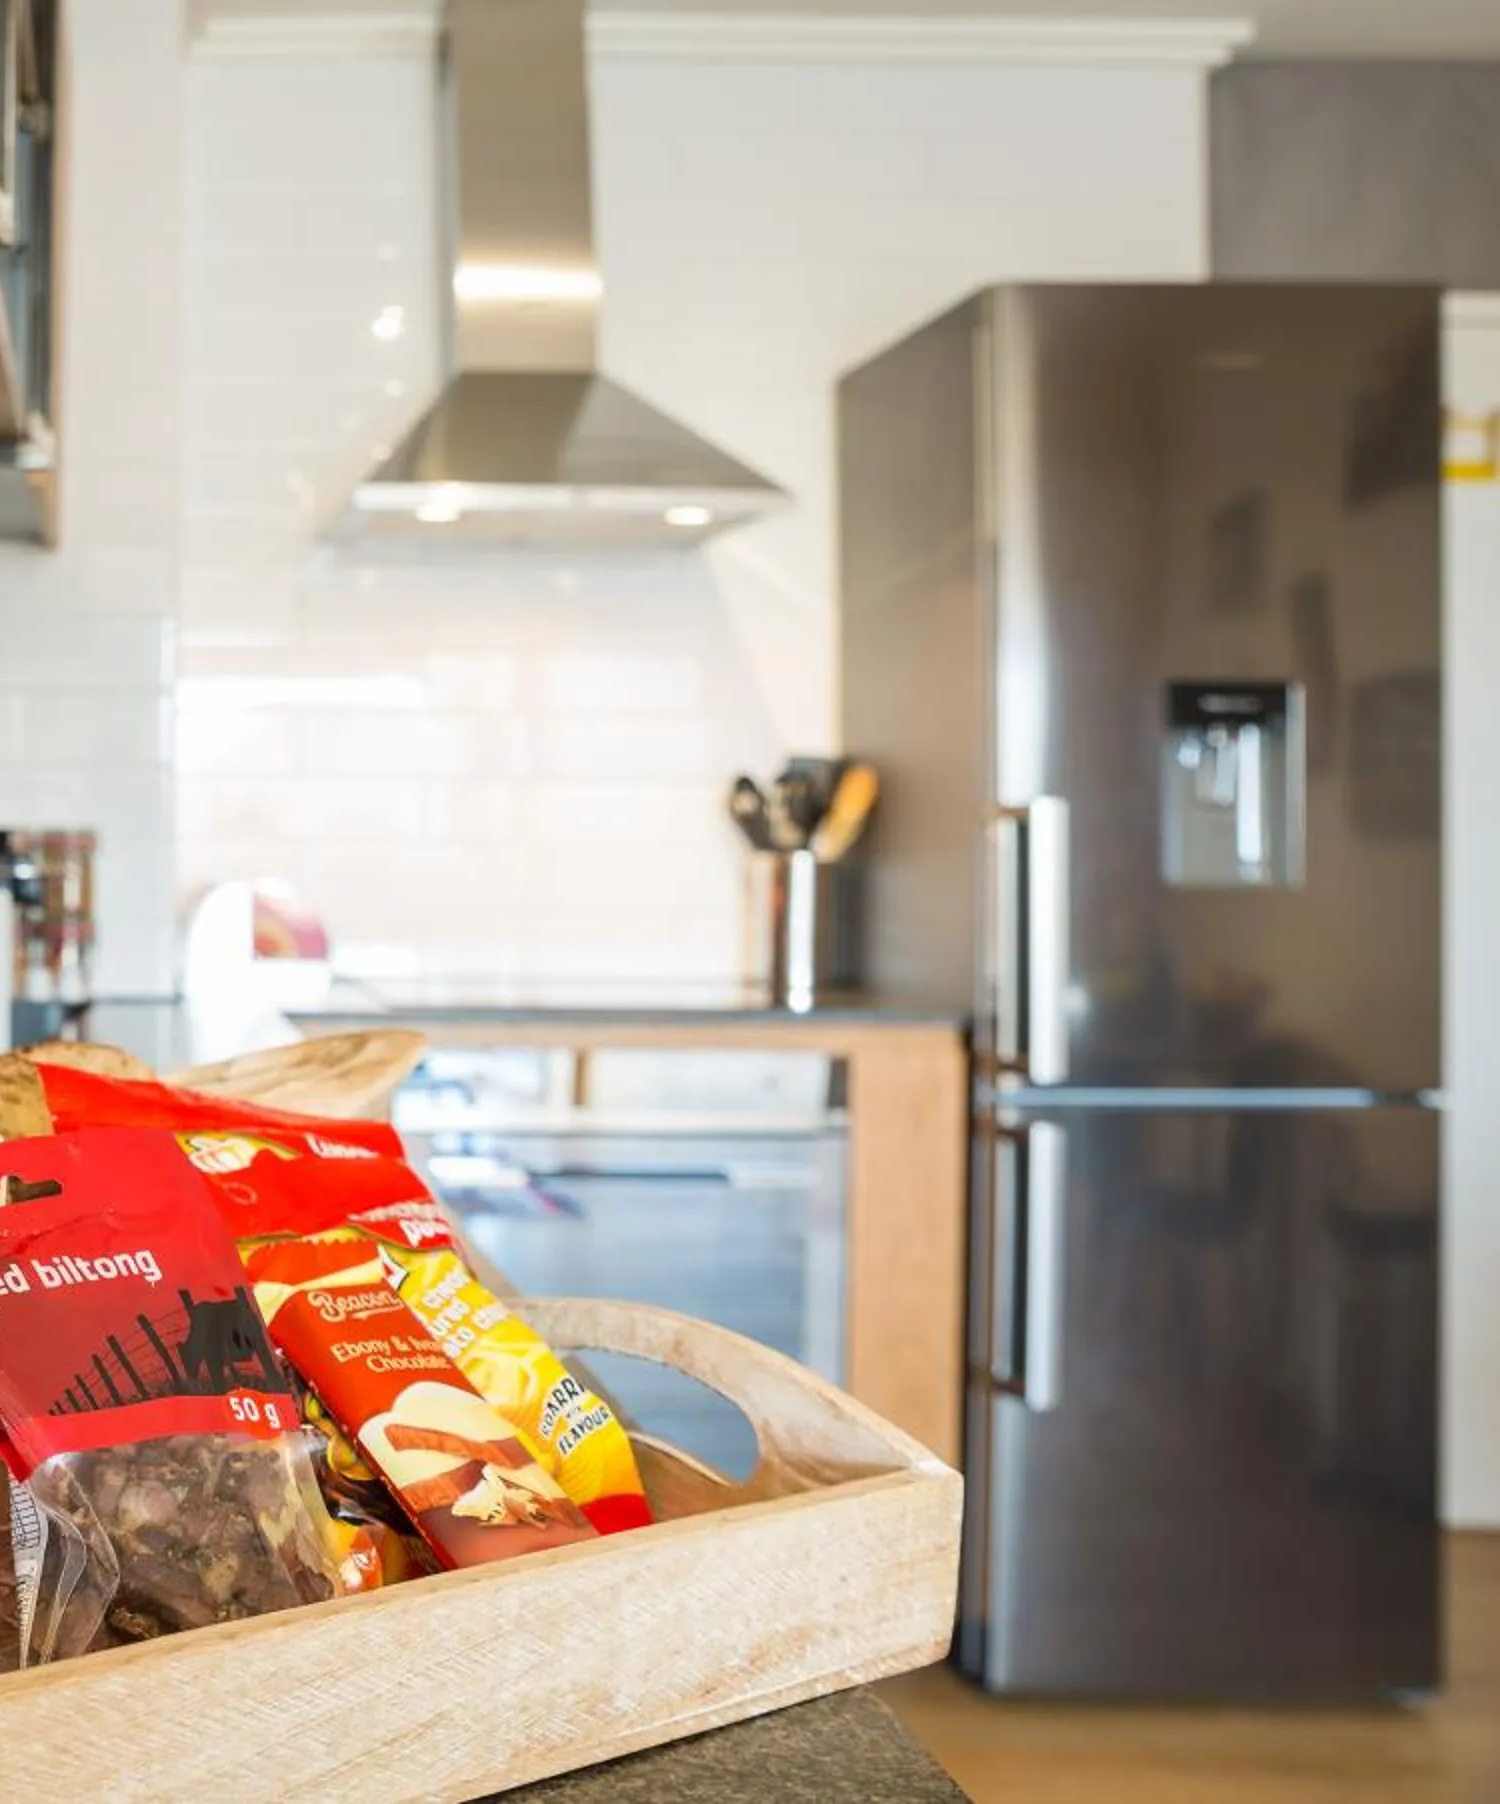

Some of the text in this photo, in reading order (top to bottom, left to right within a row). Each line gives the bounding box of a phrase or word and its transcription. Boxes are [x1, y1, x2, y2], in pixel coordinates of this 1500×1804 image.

[34, 1249, 163, 1288] biltong
[307, 1289, 403, 1322] Beacon
[330, 1338, 392, 1363] Ebony
[390, 1335, 411, 1352] &
[366, 1353, 452, 1373] Chocolate
[228, 1396, 281, 1429] 50 g
[558, 1405, 609, 1455] FLAVOUR
